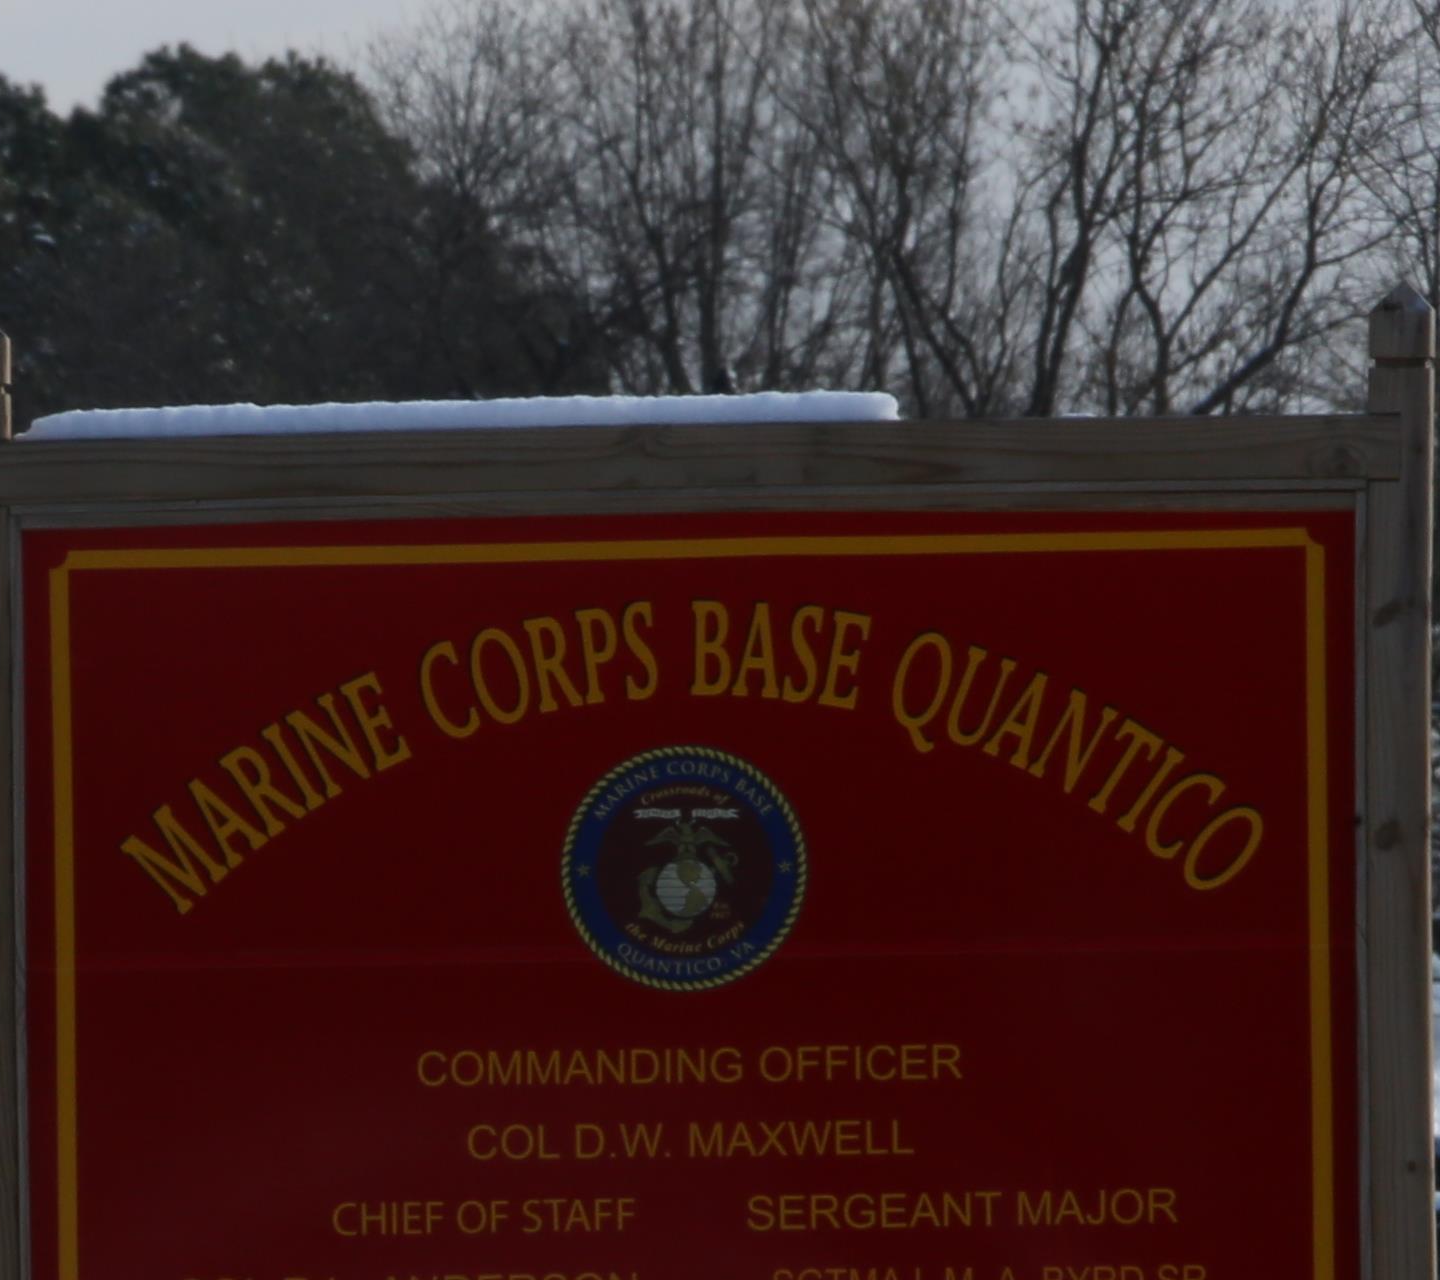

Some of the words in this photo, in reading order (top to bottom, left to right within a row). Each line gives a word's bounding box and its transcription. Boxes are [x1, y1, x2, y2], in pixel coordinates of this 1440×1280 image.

[120, 671, 412, 915] MARINE
[419, 600, 659, 739] CORPS
[690, 599, 872, 710] BASE
[891, 631, 1264, 892] QUANTICO
[594, 765, 660, 820] MARINE
[666, 761, 730, 783] CORPS
[734, 778, 776, 815] BASE
[730, 939, 757, 961] VA
[415, 1046, 744, 1087] COMMANDING
[759, 1043, 964, 1084] OFFICER
[466, 1122, 562, 1161] COL
[573, 1122, 672, 1160] D.W.
[688, 1119, 916, 1158] MAXWELL
[331, 1200, 446, 1237] CHIEF
[456, 1199, 511, 1235] OF
[521, 1197, 636, 1234] STAFF
[745, 1191, 1004, 1232] SERGEANT
[1017, 1187, 1179, 1226] MAJOR
